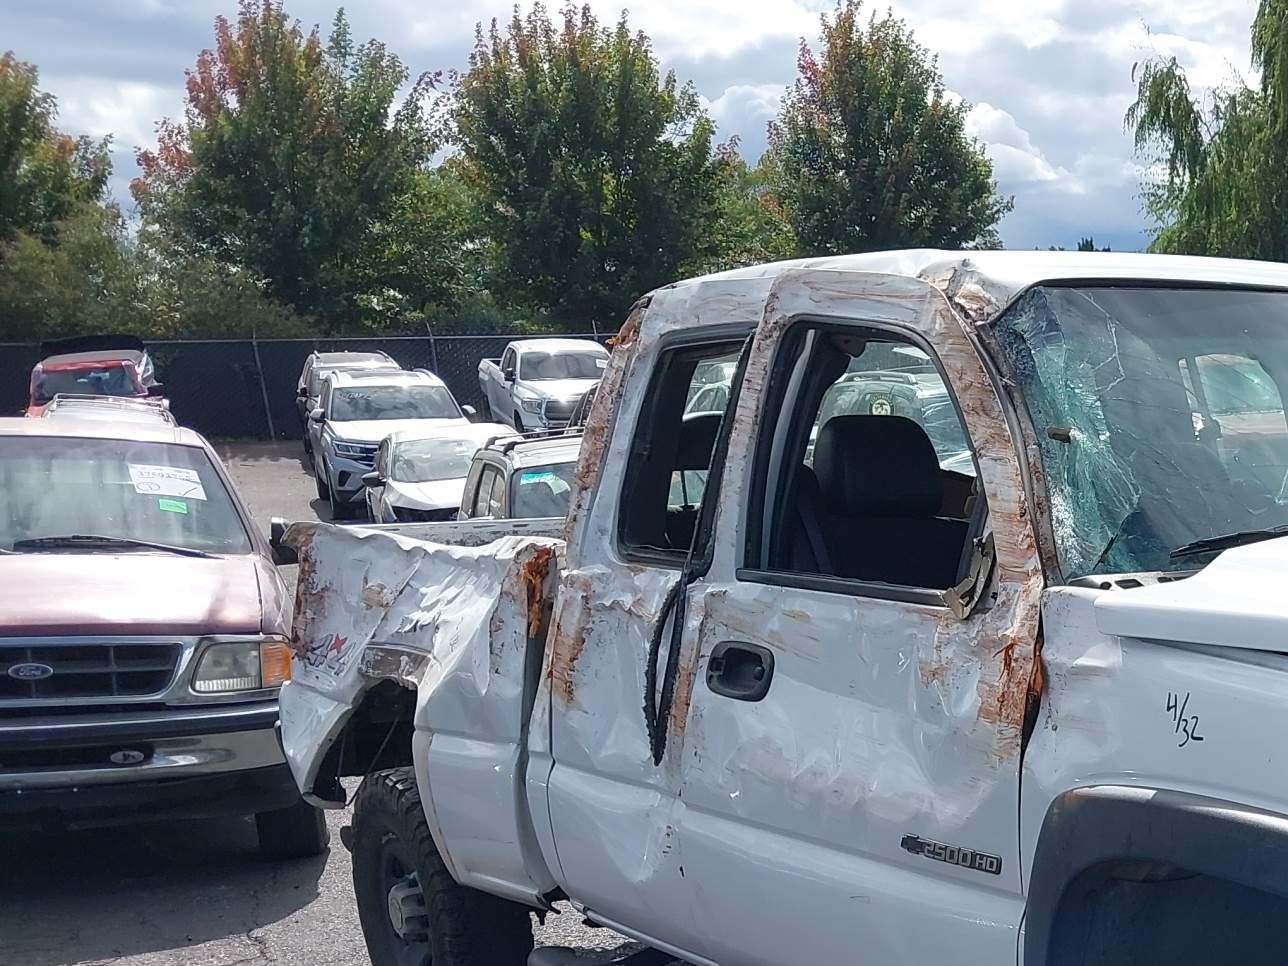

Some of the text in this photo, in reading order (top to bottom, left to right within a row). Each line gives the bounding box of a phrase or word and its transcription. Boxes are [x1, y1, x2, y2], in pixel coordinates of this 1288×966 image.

[1166, 691, 1204, 748] 4/32
[924, 841, 998, 873] 2500 HD
